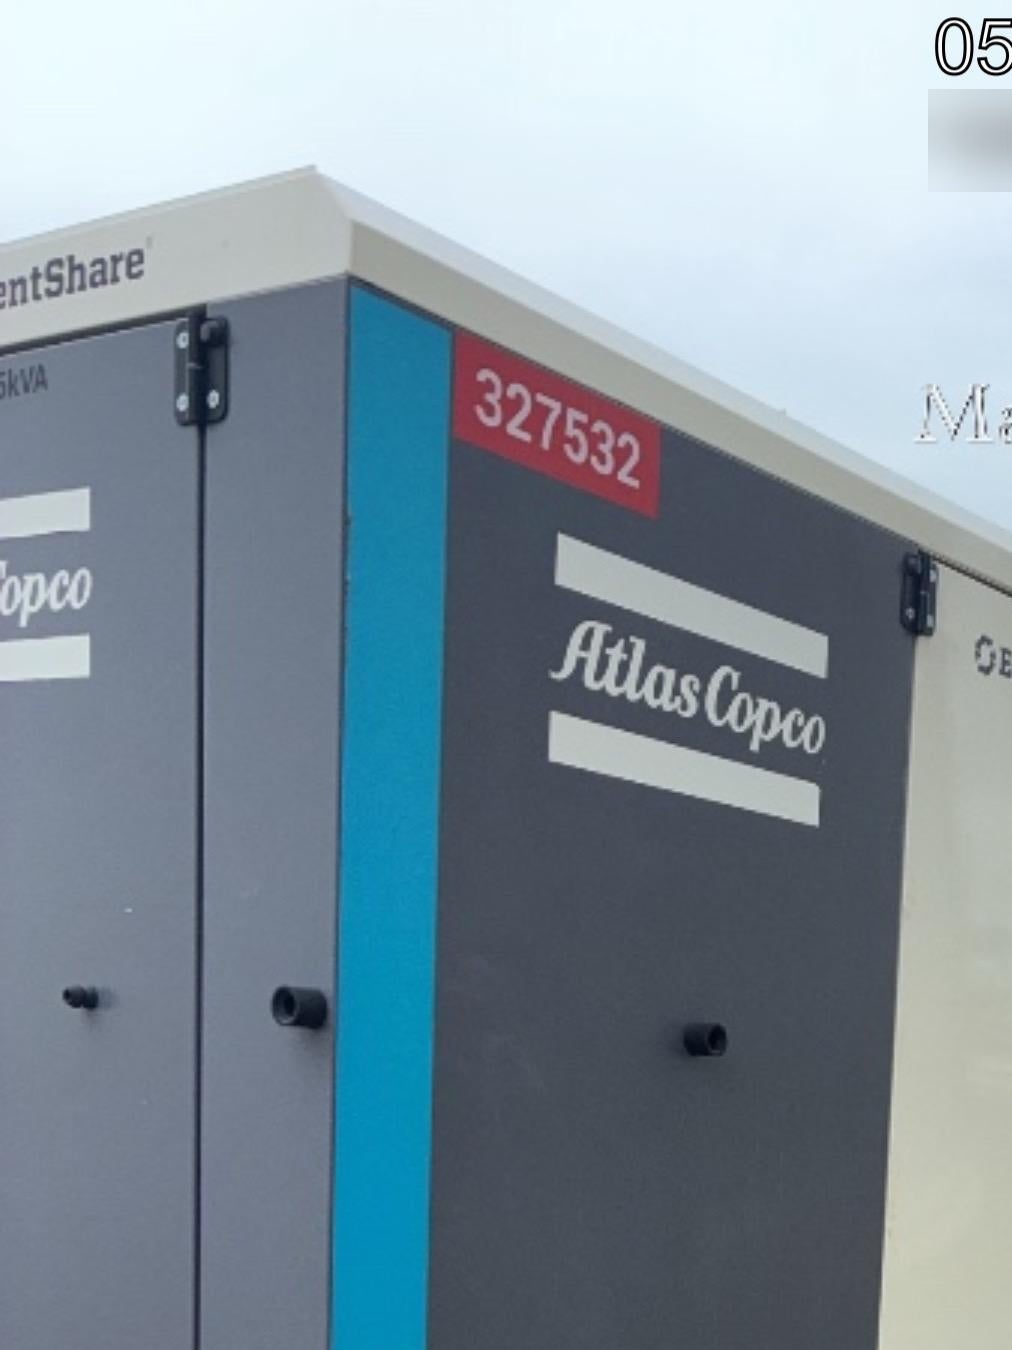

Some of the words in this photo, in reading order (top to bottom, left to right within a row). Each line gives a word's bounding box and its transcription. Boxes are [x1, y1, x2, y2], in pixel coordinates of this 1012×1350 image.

[474, 367, 641, 490] 327532
[0, 560, 91, 628] opco
[549, 619, 701, 718] Atlas
[704, 665, 826, 754] Copco
